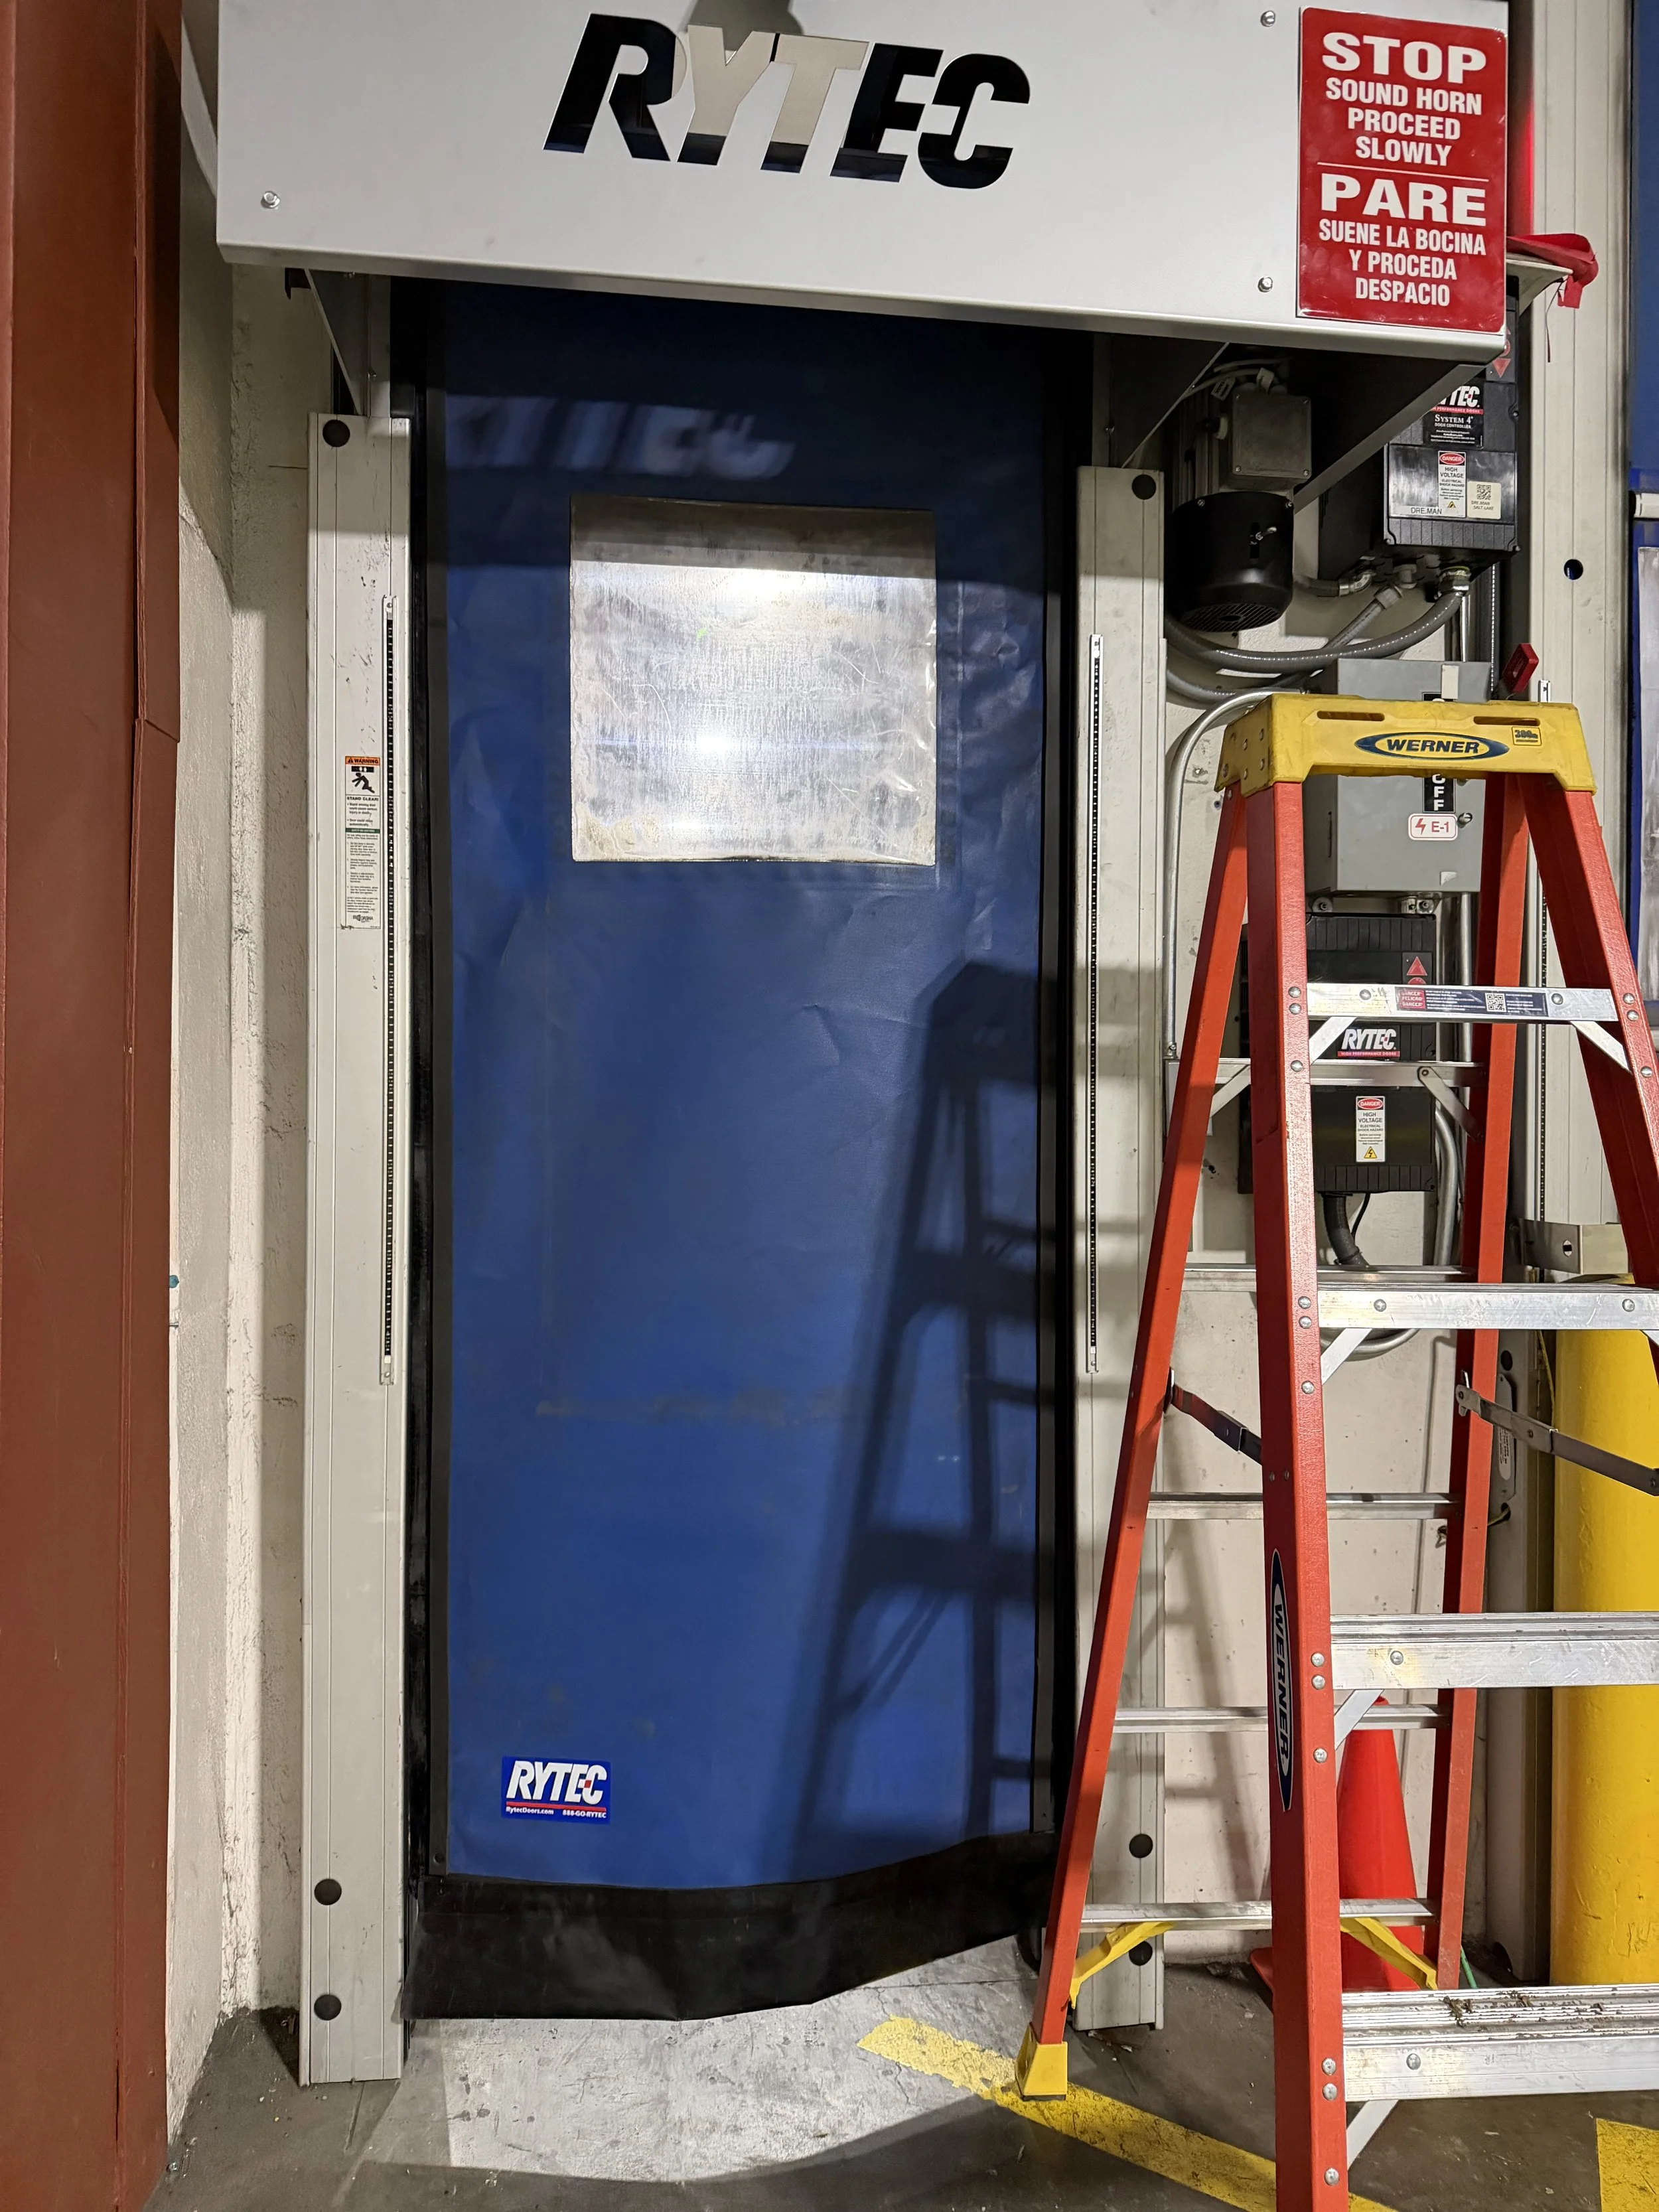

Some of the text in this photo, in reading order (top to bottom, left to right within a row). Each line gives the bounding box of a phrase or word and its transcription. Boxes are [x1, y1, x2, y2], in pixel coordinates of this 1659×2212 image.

[1322, 32, 1486, 84] STOP
[542, 13, 1031, 189] RYTEC
[1326, 78, 1482, 115] SOUND HORN
[1348, 108, 1461, 139] PROCEED
[1356, 136, 1451, 166] SLOWLY
[1321, 173, 1486, 226] PARE
[1319, 218, 1486, 256] SUENE LA BOCINA
[1349, 250, 1457, 279] Y PROCEDA
[1356, 277, 1450, 307] DESPACIO
[1439, 386, 1480, 407] TEC
[1386, 739, 1479, 754] WERNER
[1431, 822, 1449, 833] E-1
[1341, 1029, 1397, 1050] RYTEC
[1275, 1603, 1289, 1761] WERNER
[506, 1760, 607, 1805] RYTEC
[506, 1806, 607, 1818] RytecDoors.com 888-GO-RYTEC
